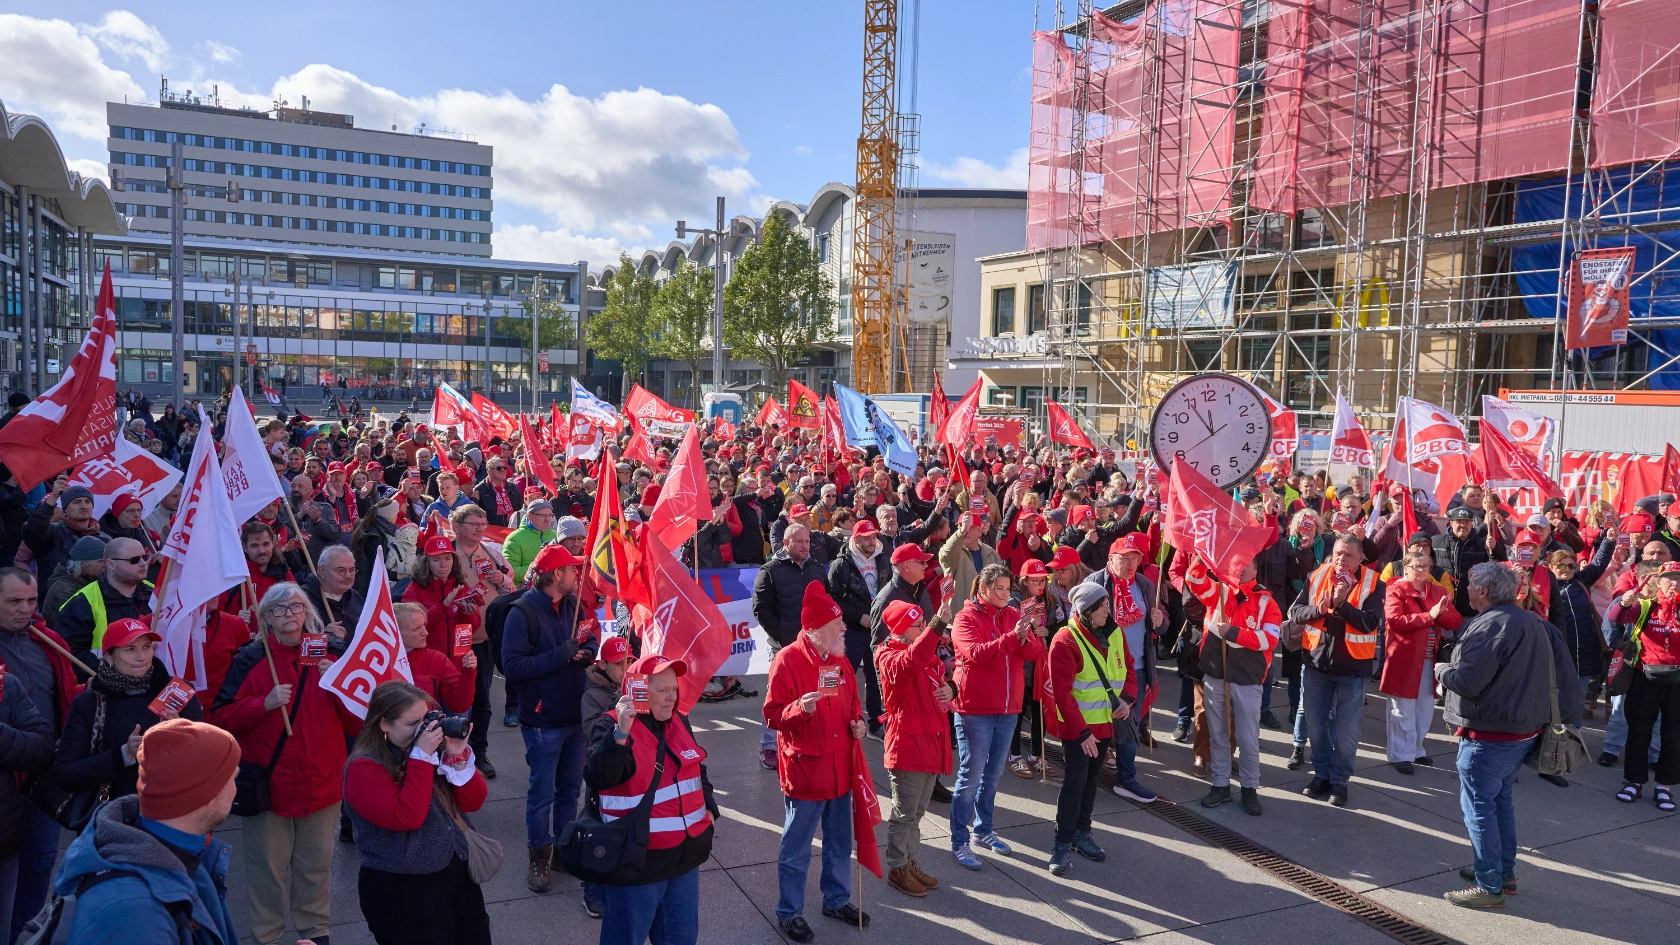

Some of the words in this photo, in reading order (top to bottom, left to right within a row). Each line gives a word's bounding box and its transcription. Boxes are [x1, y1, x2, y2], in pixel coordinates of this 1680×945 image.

[1201, 389, 1216, 402] 12
[1224, 394, 1232, 405] 1
[1184, 398, 1197, 410] 11
[1238, 405, 1249, 418] 2
[799, 416, 818, 425] Metall
[1172, 412, 1189, 425] 10
[1246, 423, 1255, 434] 3
[1168, 431, 1179, 443] 9
[1242, 442, 1251, 453] 4
[1268, 440, 1296, 455] CE
[1429, 439, 1471, 453] BCE
[1176, 449, 1186, 461] 8
[1346, 448, 1375, 468] BC
[1229, 456, 1239, 468] 5
[1211, 464, 1220, 476] 6
